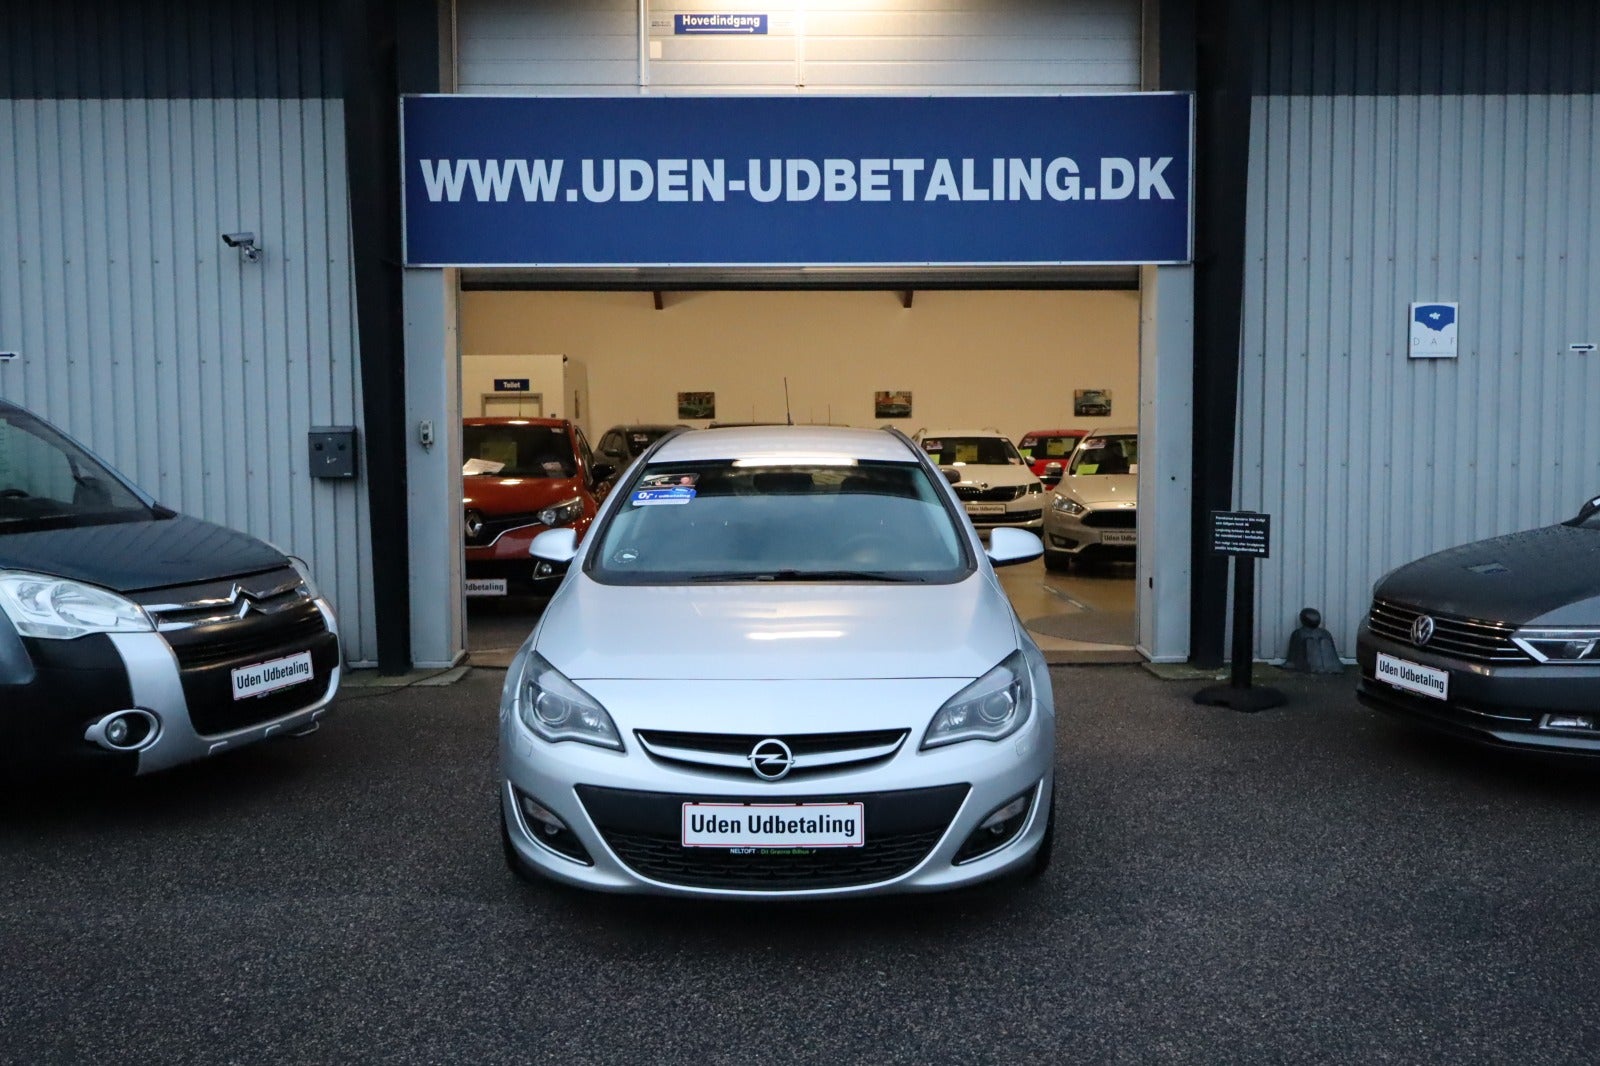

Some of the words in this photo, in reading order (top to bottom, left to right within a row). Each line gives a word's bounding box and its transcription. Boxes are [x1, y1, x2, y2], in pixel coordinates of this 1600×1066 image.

[682, 15, 760, 27] Hovedindgang
[419, 156, 1175, 202] WWW.UDEN-UDBETALING.DK
[503, 381, 520, 389] Toilet
[236, 674, 261, 690] Uden
[263, 661, 309, 682] Udbetaling
[1379, 660, 1398, 677] Uden
[1400, 666, 1444, 693] Udbetaling
[691, 814, 741, 834] Uden
[748, 814, 855, 838] Udbetaling
